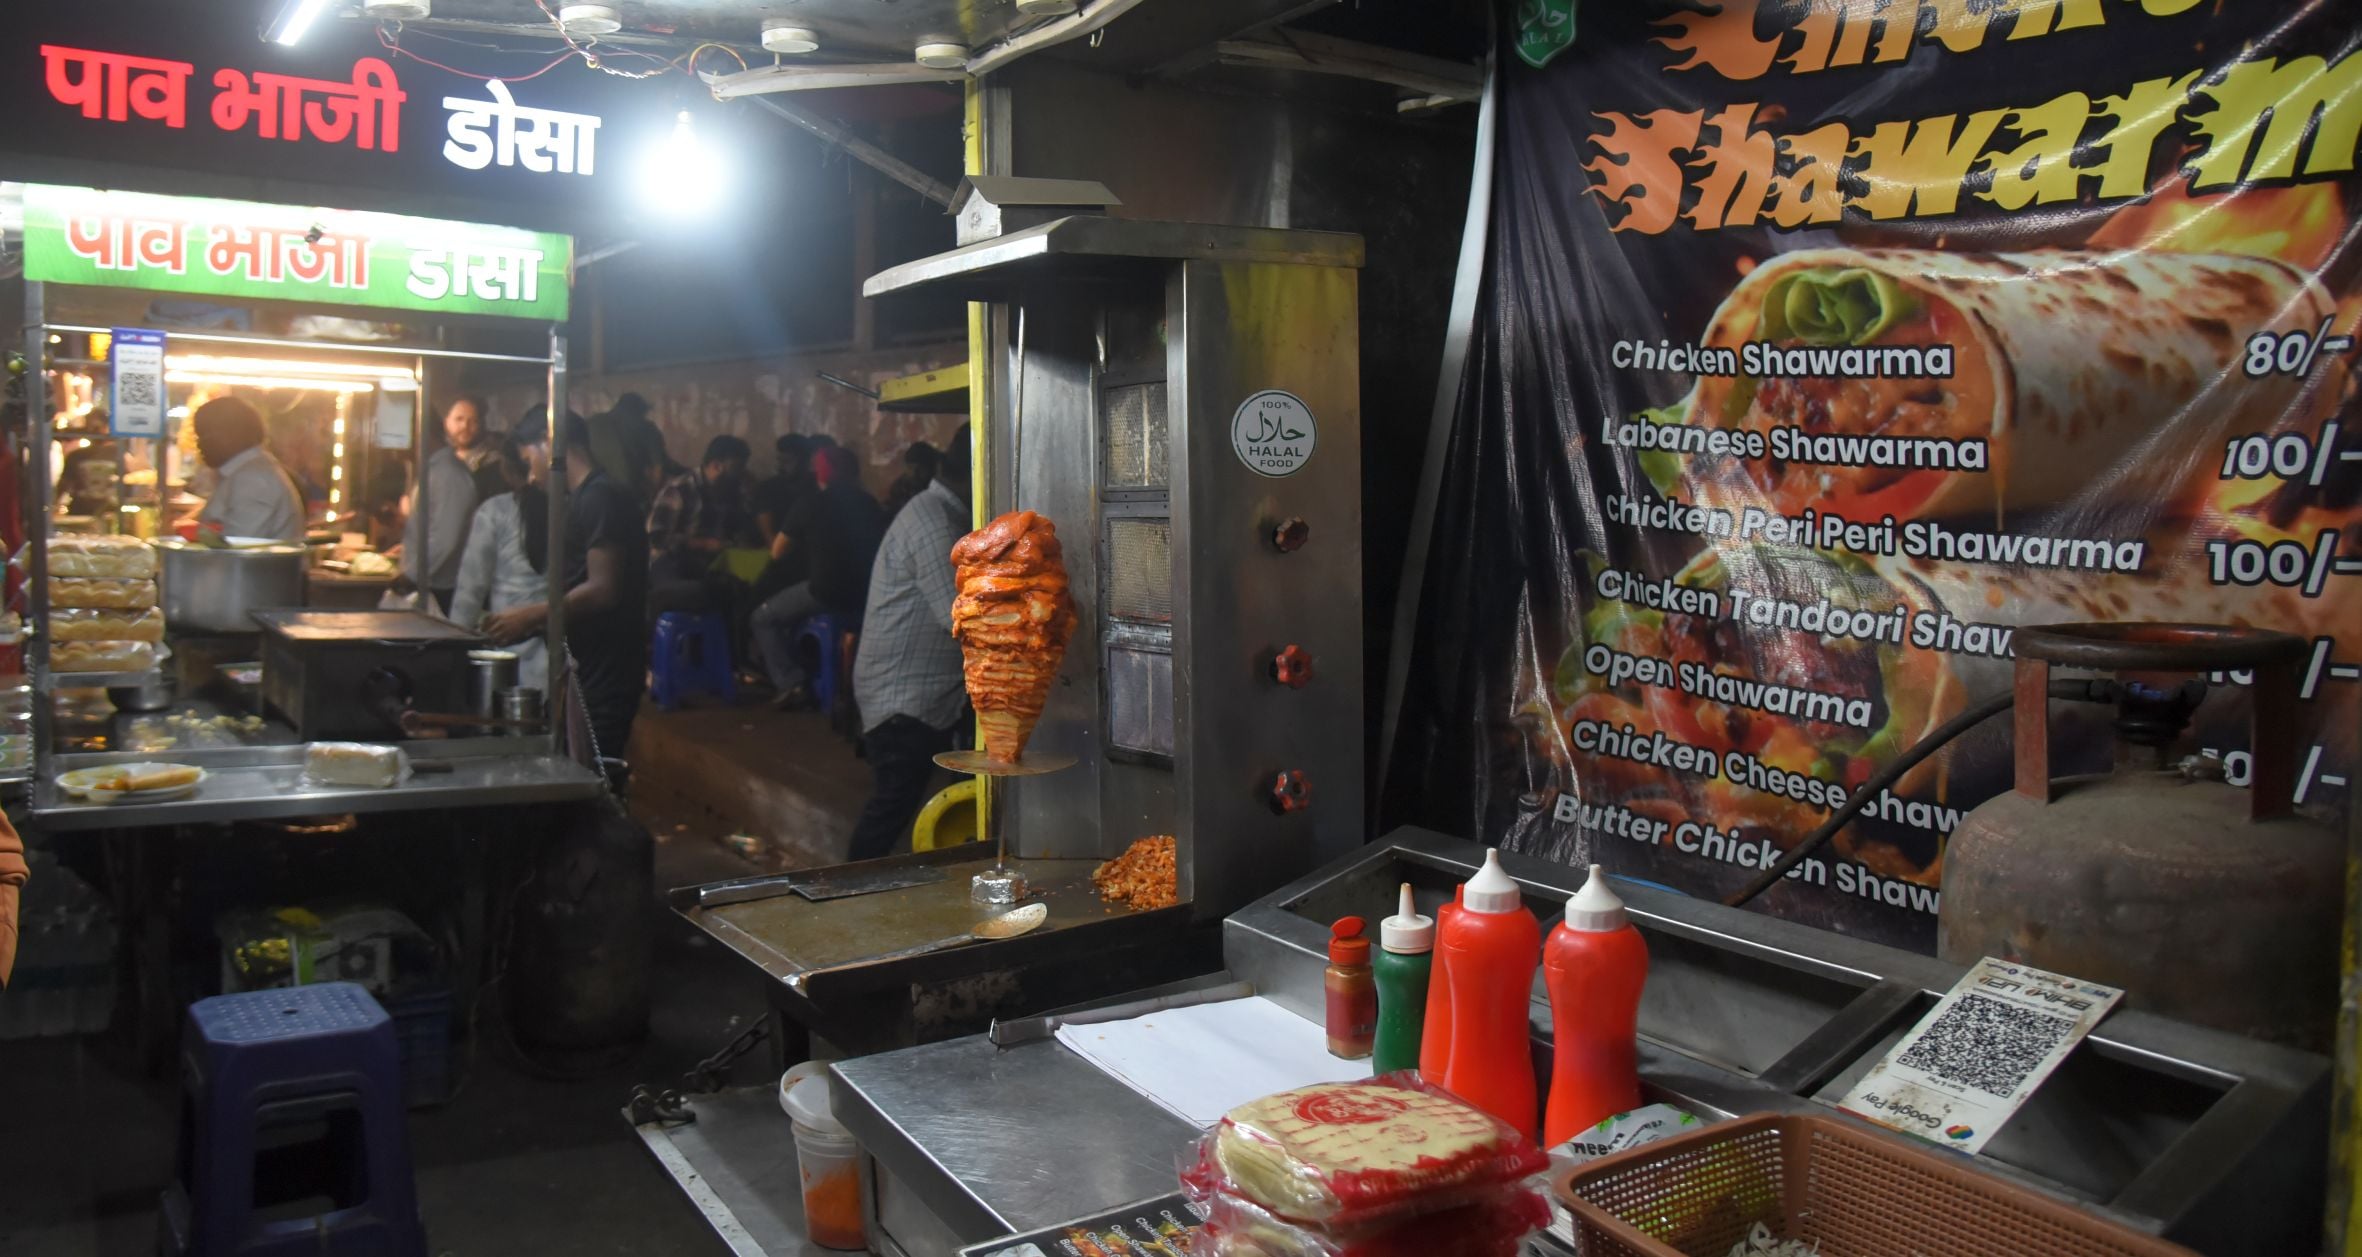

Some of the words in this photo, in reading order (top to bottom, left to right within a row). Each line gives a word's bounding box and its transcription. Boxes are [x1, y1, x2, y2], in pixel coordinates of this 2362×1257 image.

[41, 44, 194, 130] पाव
[211, 57, 407, 153] भाजी
[442, 78, 602, 177] डोसा
[67, 212, 190, 275] पाव
[1611, 340, 1736, 377] Chicken
[1743, 344, 1953, 378] Shawarma
[2246, 316, 2353, 379] 80/-
[1245, 410, 1306, 443] حلال
[1261, 401, 1292, 409] 100%
[1249, 446, 1303, 457] HALAL
[1260, 460, 1293, 468] FOOD
[1602, 418, 1763, 459] Labanese
[1769, 426, 1986, 470] Shawarma
[2223, 422, 2362, 486] 100/-
[1606, 494, 1731, 537] Chicken
[1741, 509, 1815, 547] Peri
[1822, 515, 1893, 553] Peri
[1904, 523, 2143, 571] Shawarma
[2210, 530, 2362, 594] 100/-
[1598, 570, 1718, 618] Chicken
[1729, 588, 1905, 643] Tandoori
[1585, 645, 1674, 689] Open
[1680, 662, 1871, 727] Shawarma
[1573, 720, 1717, 779] Chicken
[1725, 752, 1847, 808] Cheese
[1554, 793, 1668, 845] Butter
[1860, 1091, 1889, 1109] Pay
[1887, 1102, 1942, 1129] Google
[1111, 1224, 1131, 1241] Open
[1136, 1217, 1165, 1242] Chicken
